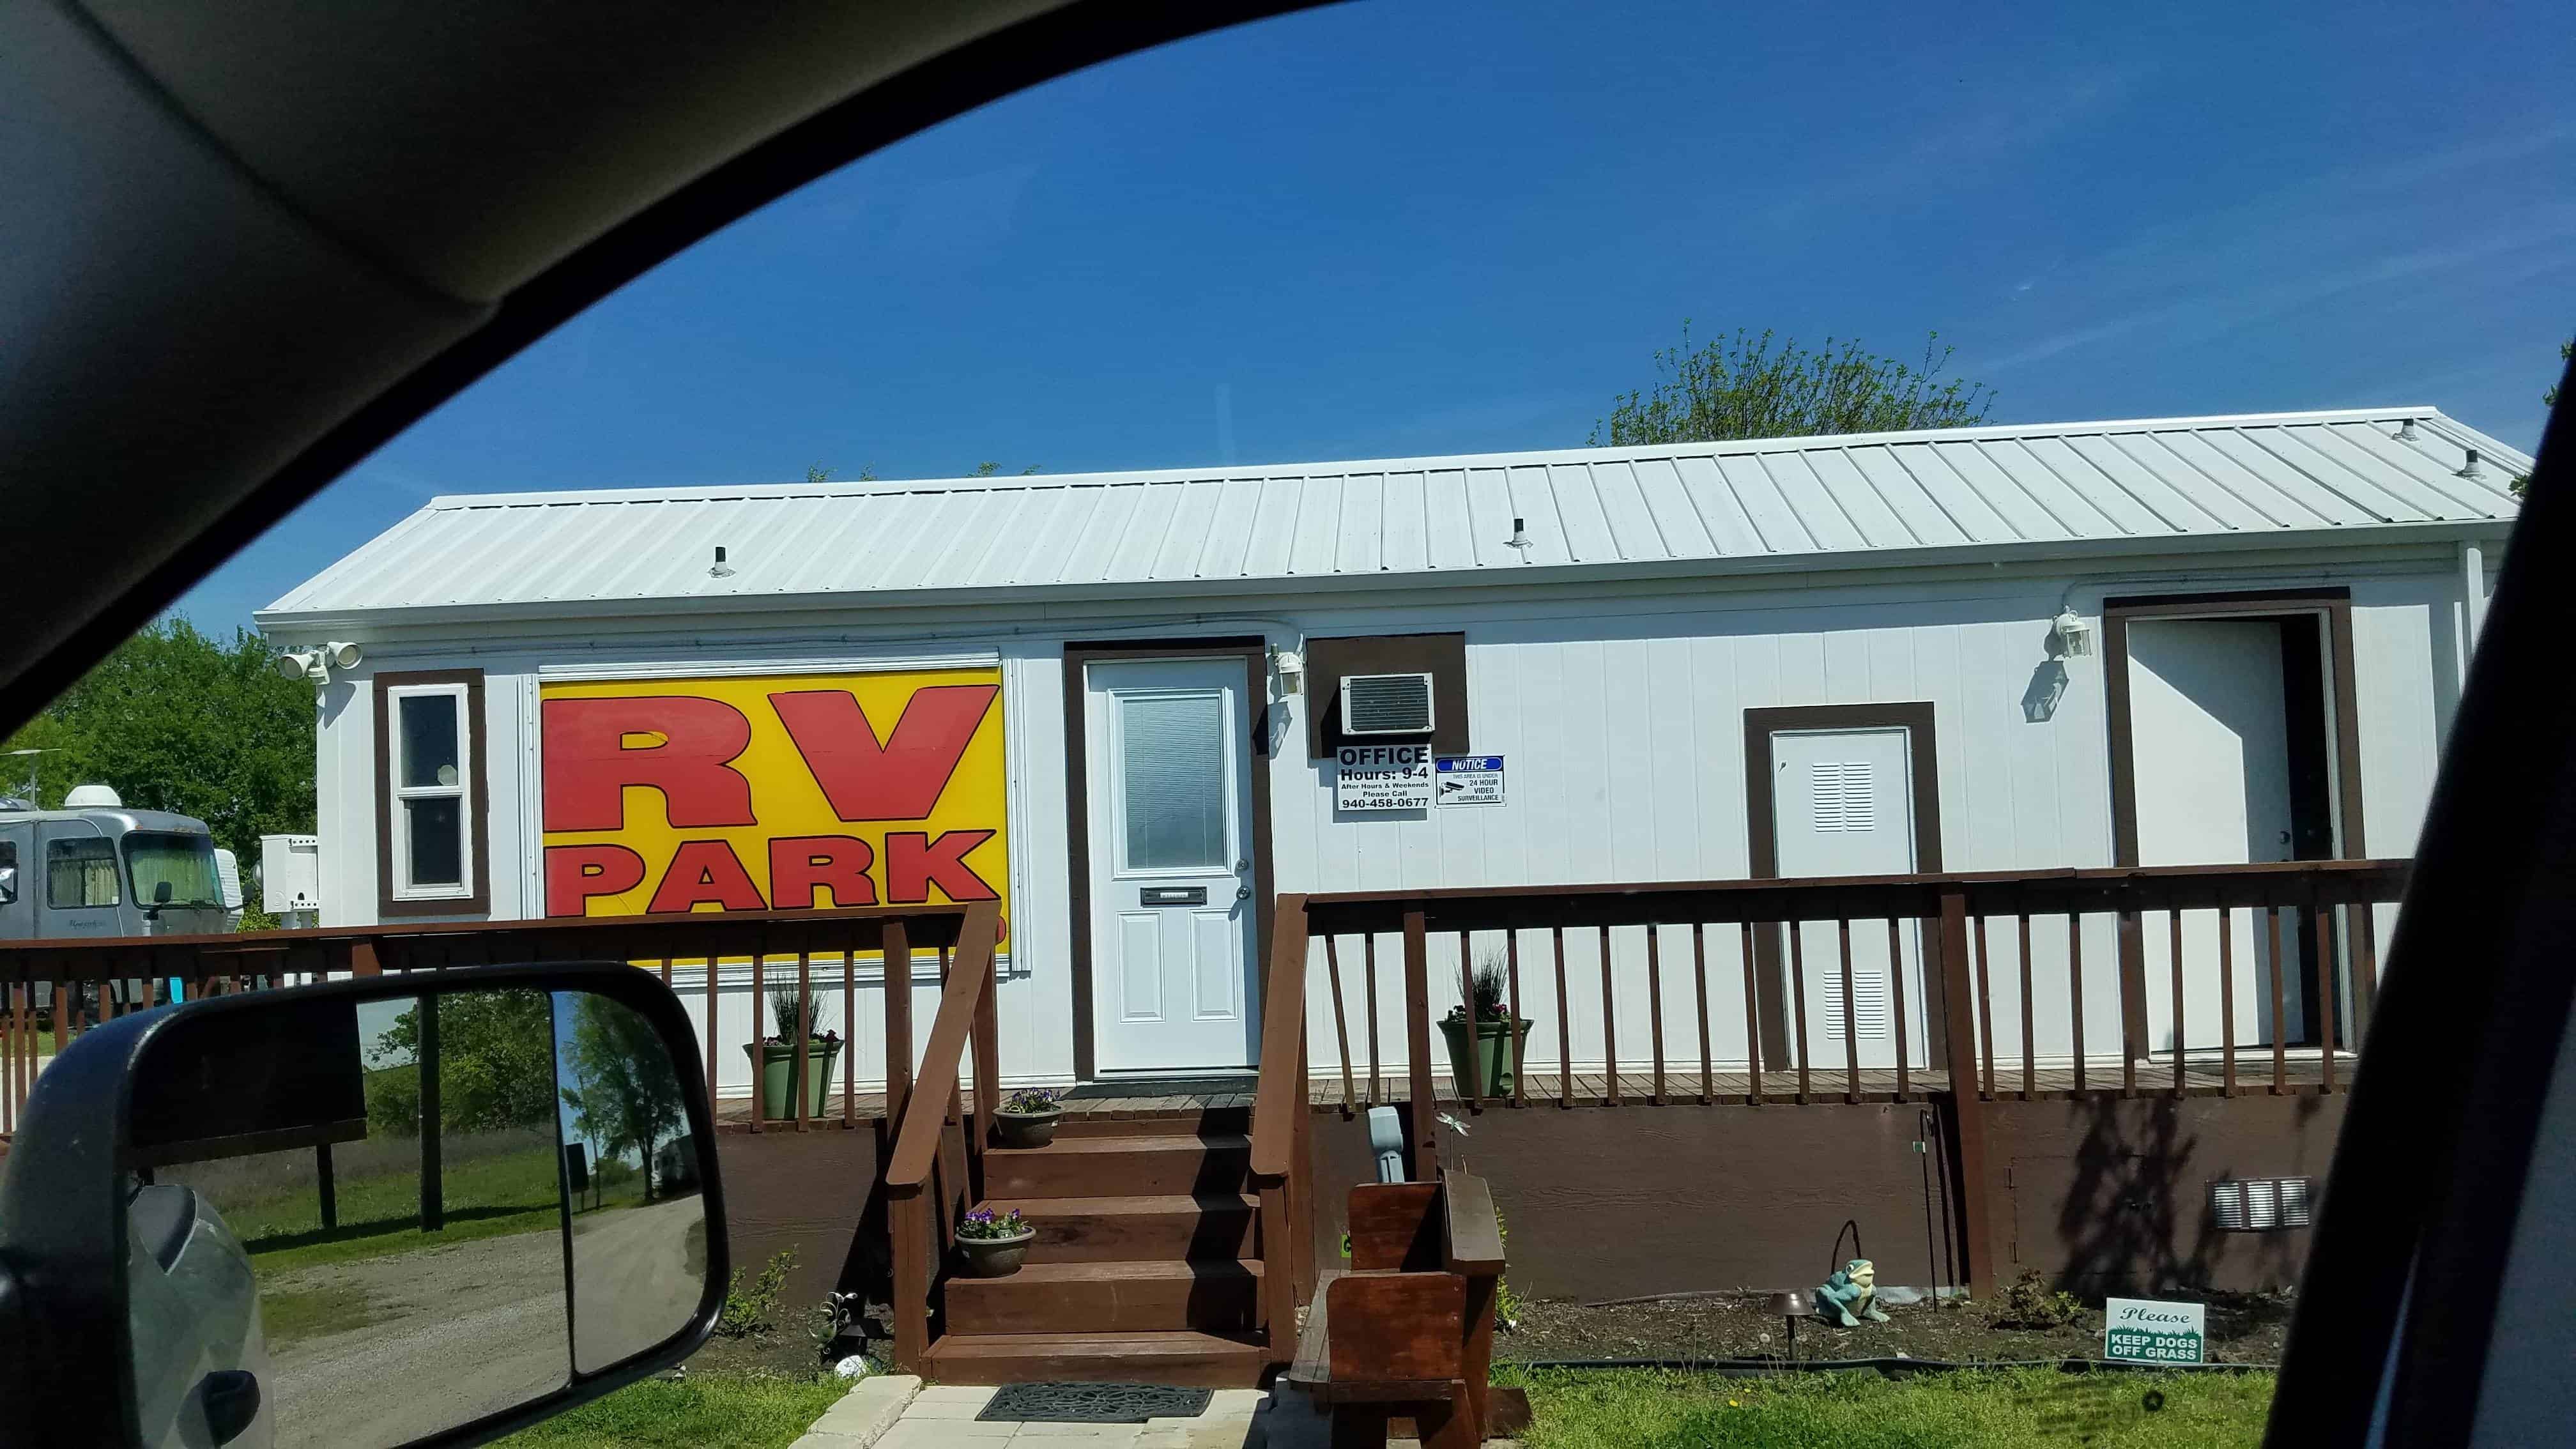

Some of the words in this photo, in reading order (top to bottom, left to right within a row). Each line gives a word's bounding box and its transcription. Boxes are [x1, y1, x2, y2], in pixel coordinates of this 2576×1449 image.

[542, 684, 1000, 833] RV
[1340, 747, 1429, 765] OFFICE
[1452, 759, 1487, 770] NOTICE
[1341, 769, 1396, 781] Hours:
[1402, 767, 1429, 779] 9-4
[1342, 798, 1429, 808] 940-458-0677
[544, 829, 1002, 918] PARK
[2120, 1307, 2191, 1323] Please
[2111, 1333, 2151, 1346] KEEP
[2155, 1337, 2198, 1349] DOGS
[2112, 1345, 2141, 1356] OFF
[2145, 1347, 2196, 1360] GRASS
